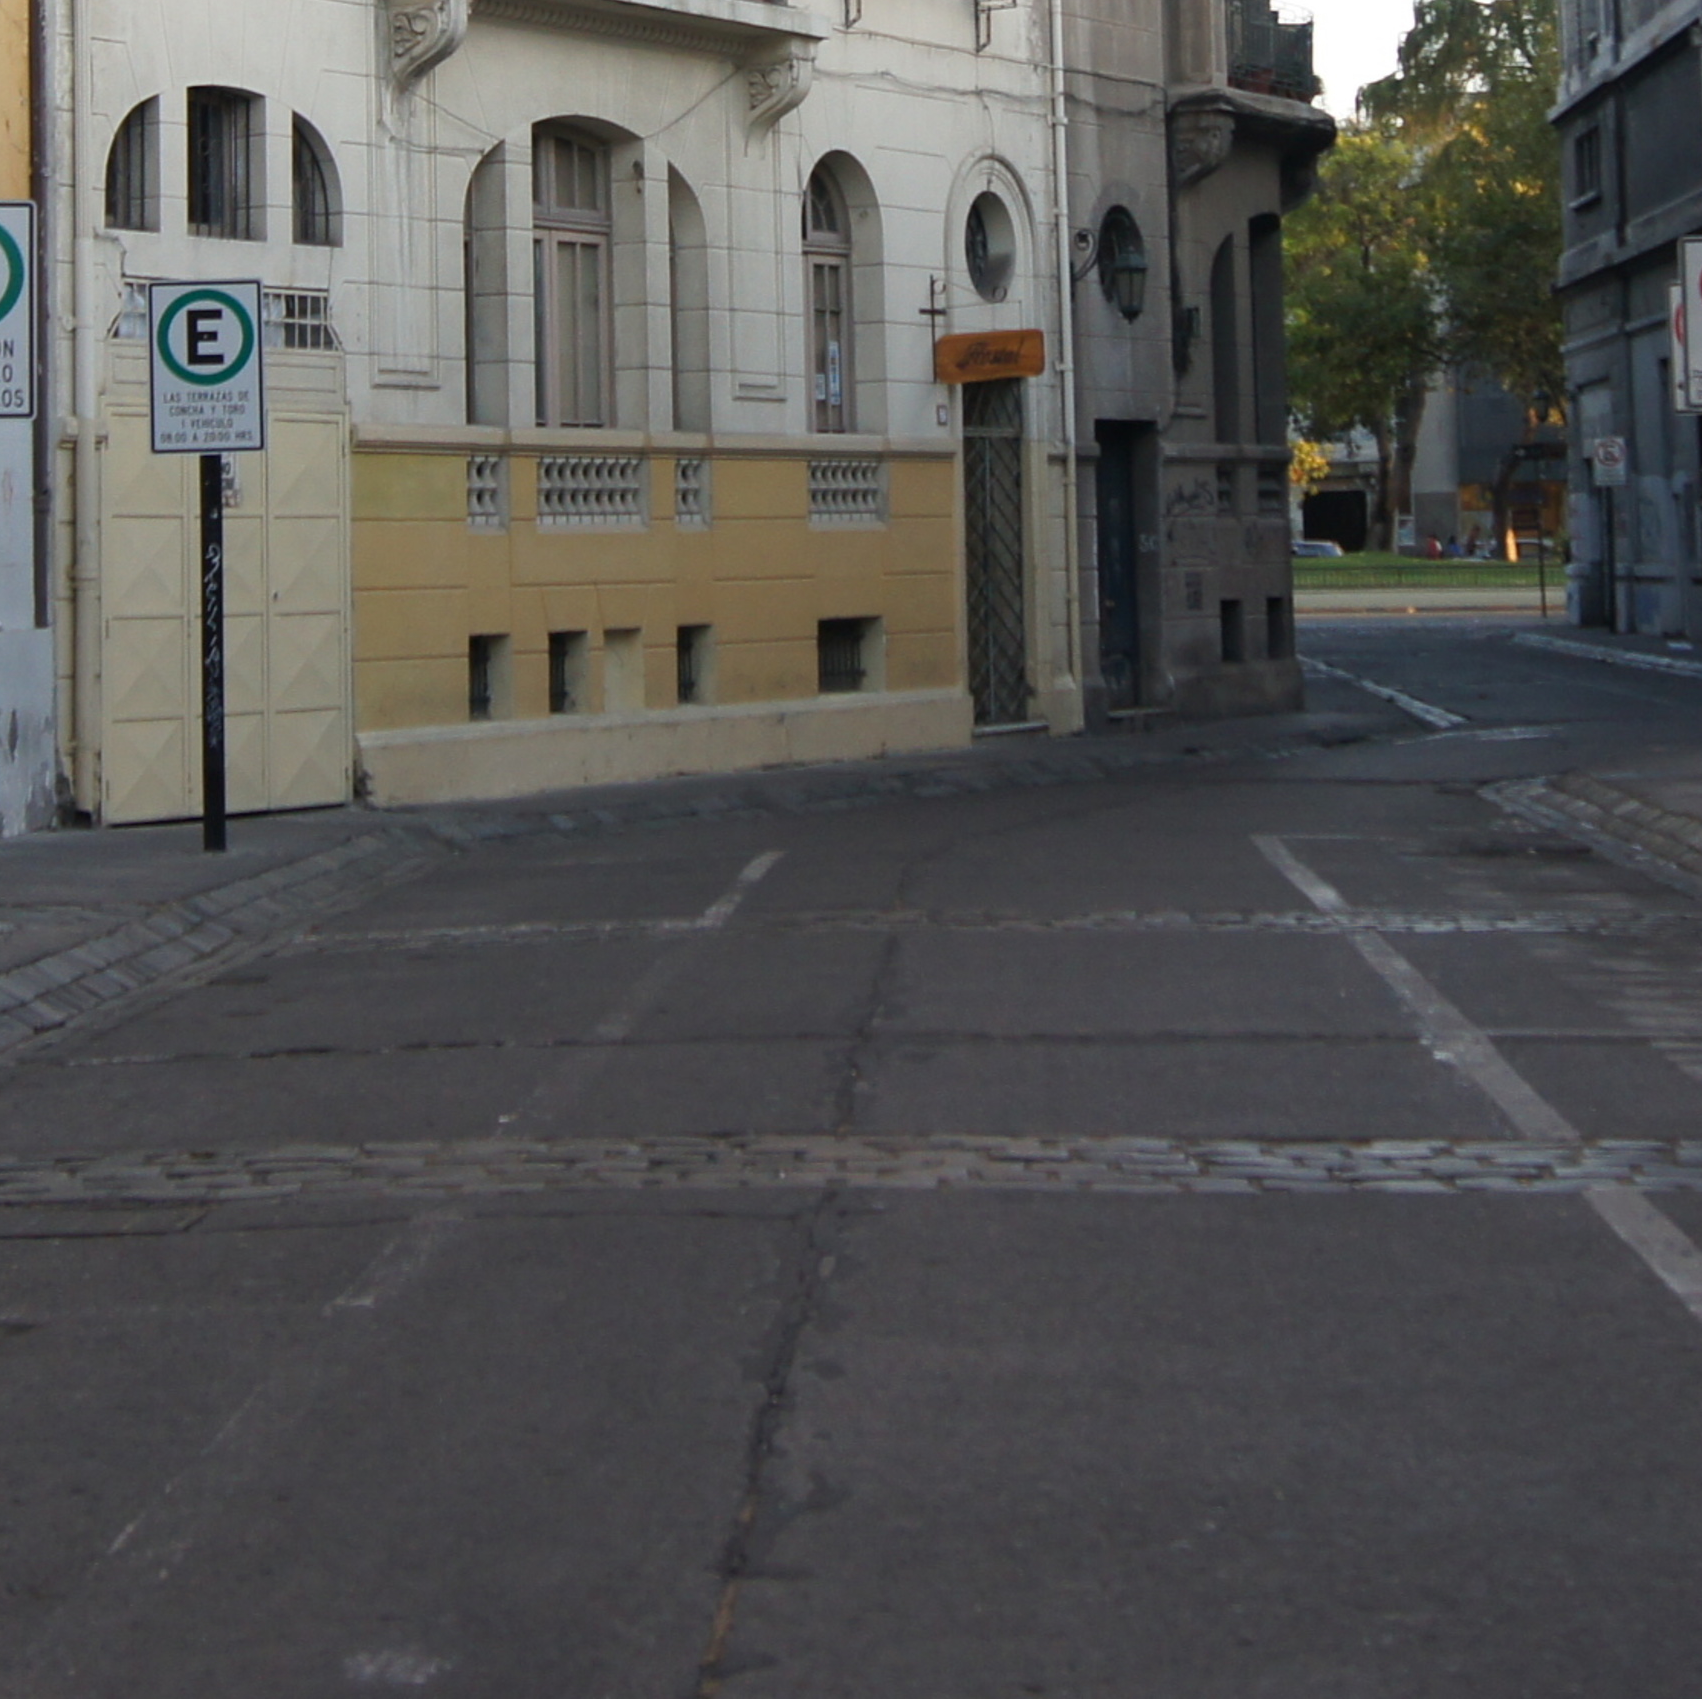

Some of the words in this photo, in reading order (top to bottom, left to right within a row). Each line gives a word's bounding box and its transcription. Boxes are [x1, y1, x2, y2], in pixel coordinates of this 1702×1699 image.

[187, 308, 225, 366] E
[162, 392, 182, 404] LAS
[186, 390, 234, 402] TERRAZAS
[237, 390, 250, 402] DE
[169, 405, 205, 417] CONCHA
[210, 405, 217, 415] Y
[222, 403, 246, 416] TORO
[190, 417, 234, 430] VEHICULO
[192, 432, 199, 442] A
